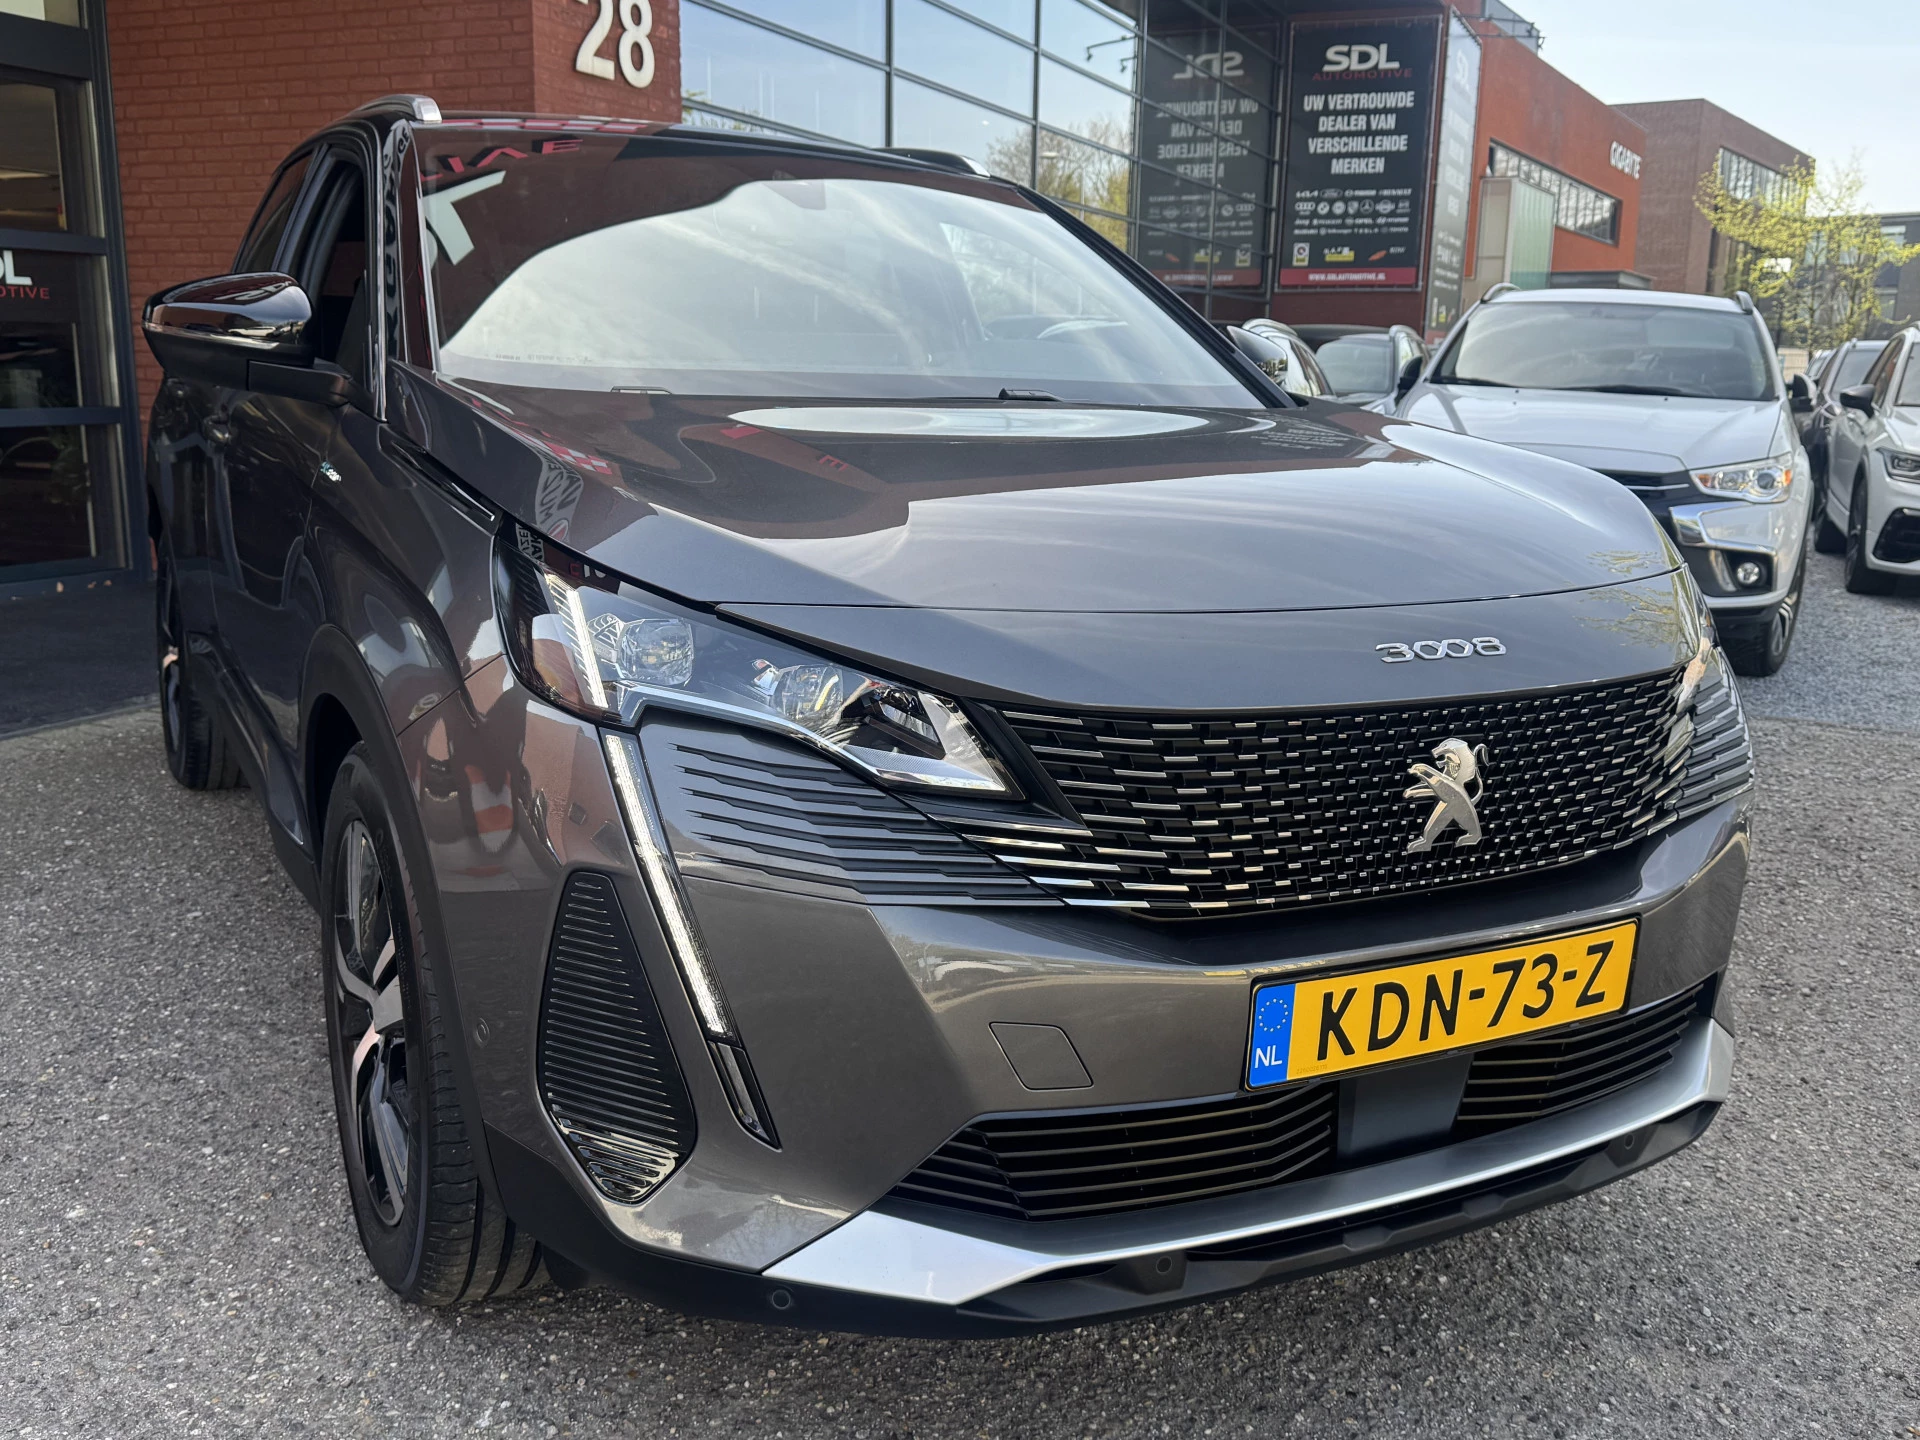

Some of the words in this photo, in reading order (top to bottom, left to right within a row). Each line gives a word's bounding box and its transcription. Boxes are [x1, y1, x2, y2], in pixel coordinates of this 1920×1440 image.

[575, 0, 655, 89] 28
[1322, 43, 1400, 72] SDL
[1312, 68, 1413, 80] AUTOMOTIVE
[1303, 95, 1325, 111] UW
[1327, 91, 1415, 110] VERTROUWDE
[1318, 115, 1367, 132] DEALER
[1370, 113, 1396, 131] VAN
[1308, 134, 1409, 154] VERSCHILLENDE
[1331, 157, 1385, 174] MERKEN
[1375, 636, 1507, 663] 3008
[1317, 940, 1614, 1061] KDN-73-Z
[1254, 1045, 1283, 1068] NL
